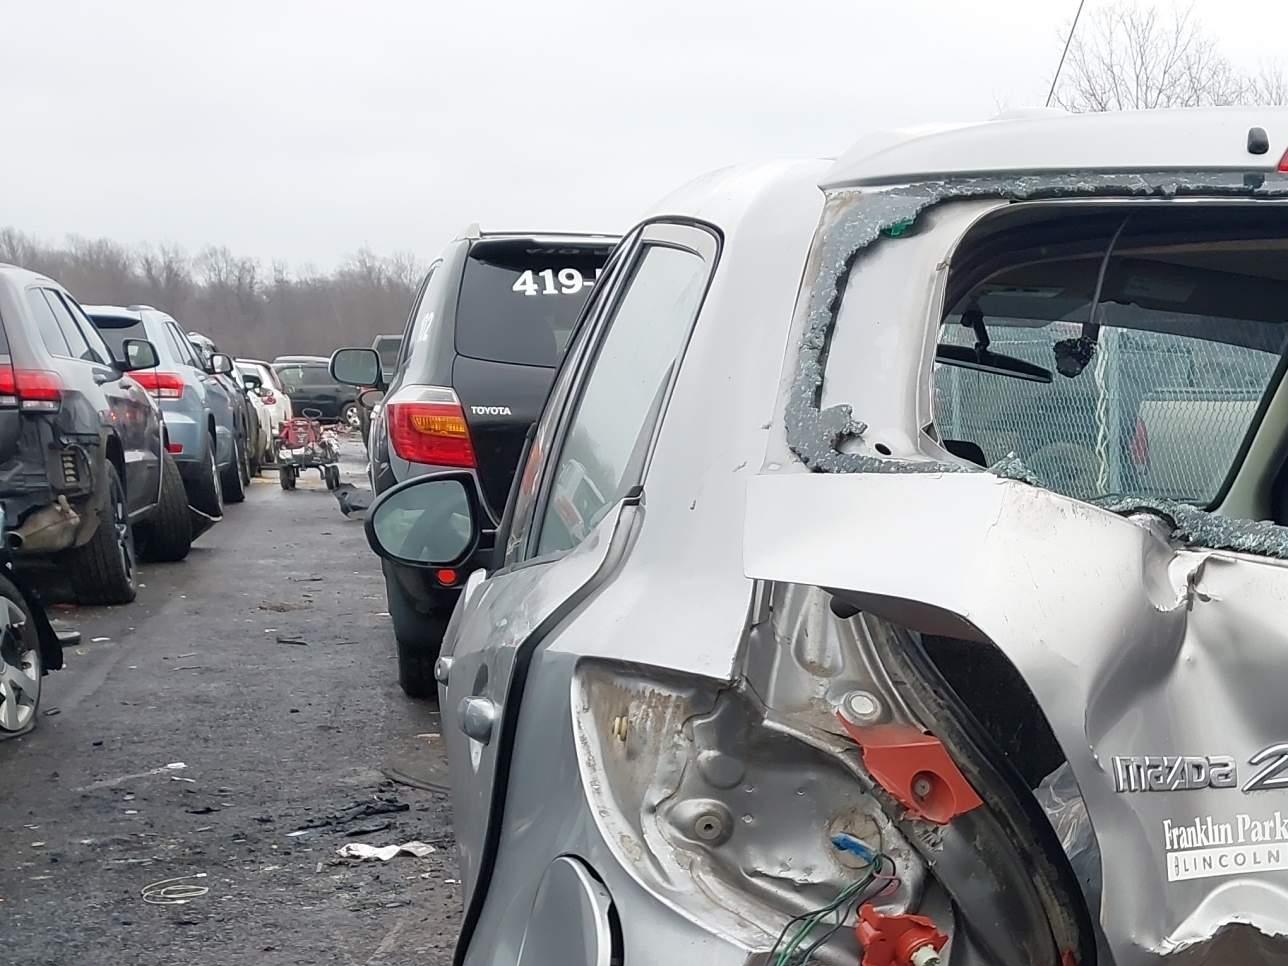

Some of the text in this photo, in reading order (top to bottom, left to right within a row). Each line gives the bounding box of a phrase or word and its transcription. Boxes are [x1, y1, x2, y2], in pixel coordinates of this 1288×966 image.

[471, 405, 512, 415] TOYOTA
[1163, 816, 1233, 850] Franklin
[1183, 849, 1280, 872] LINCOLN
